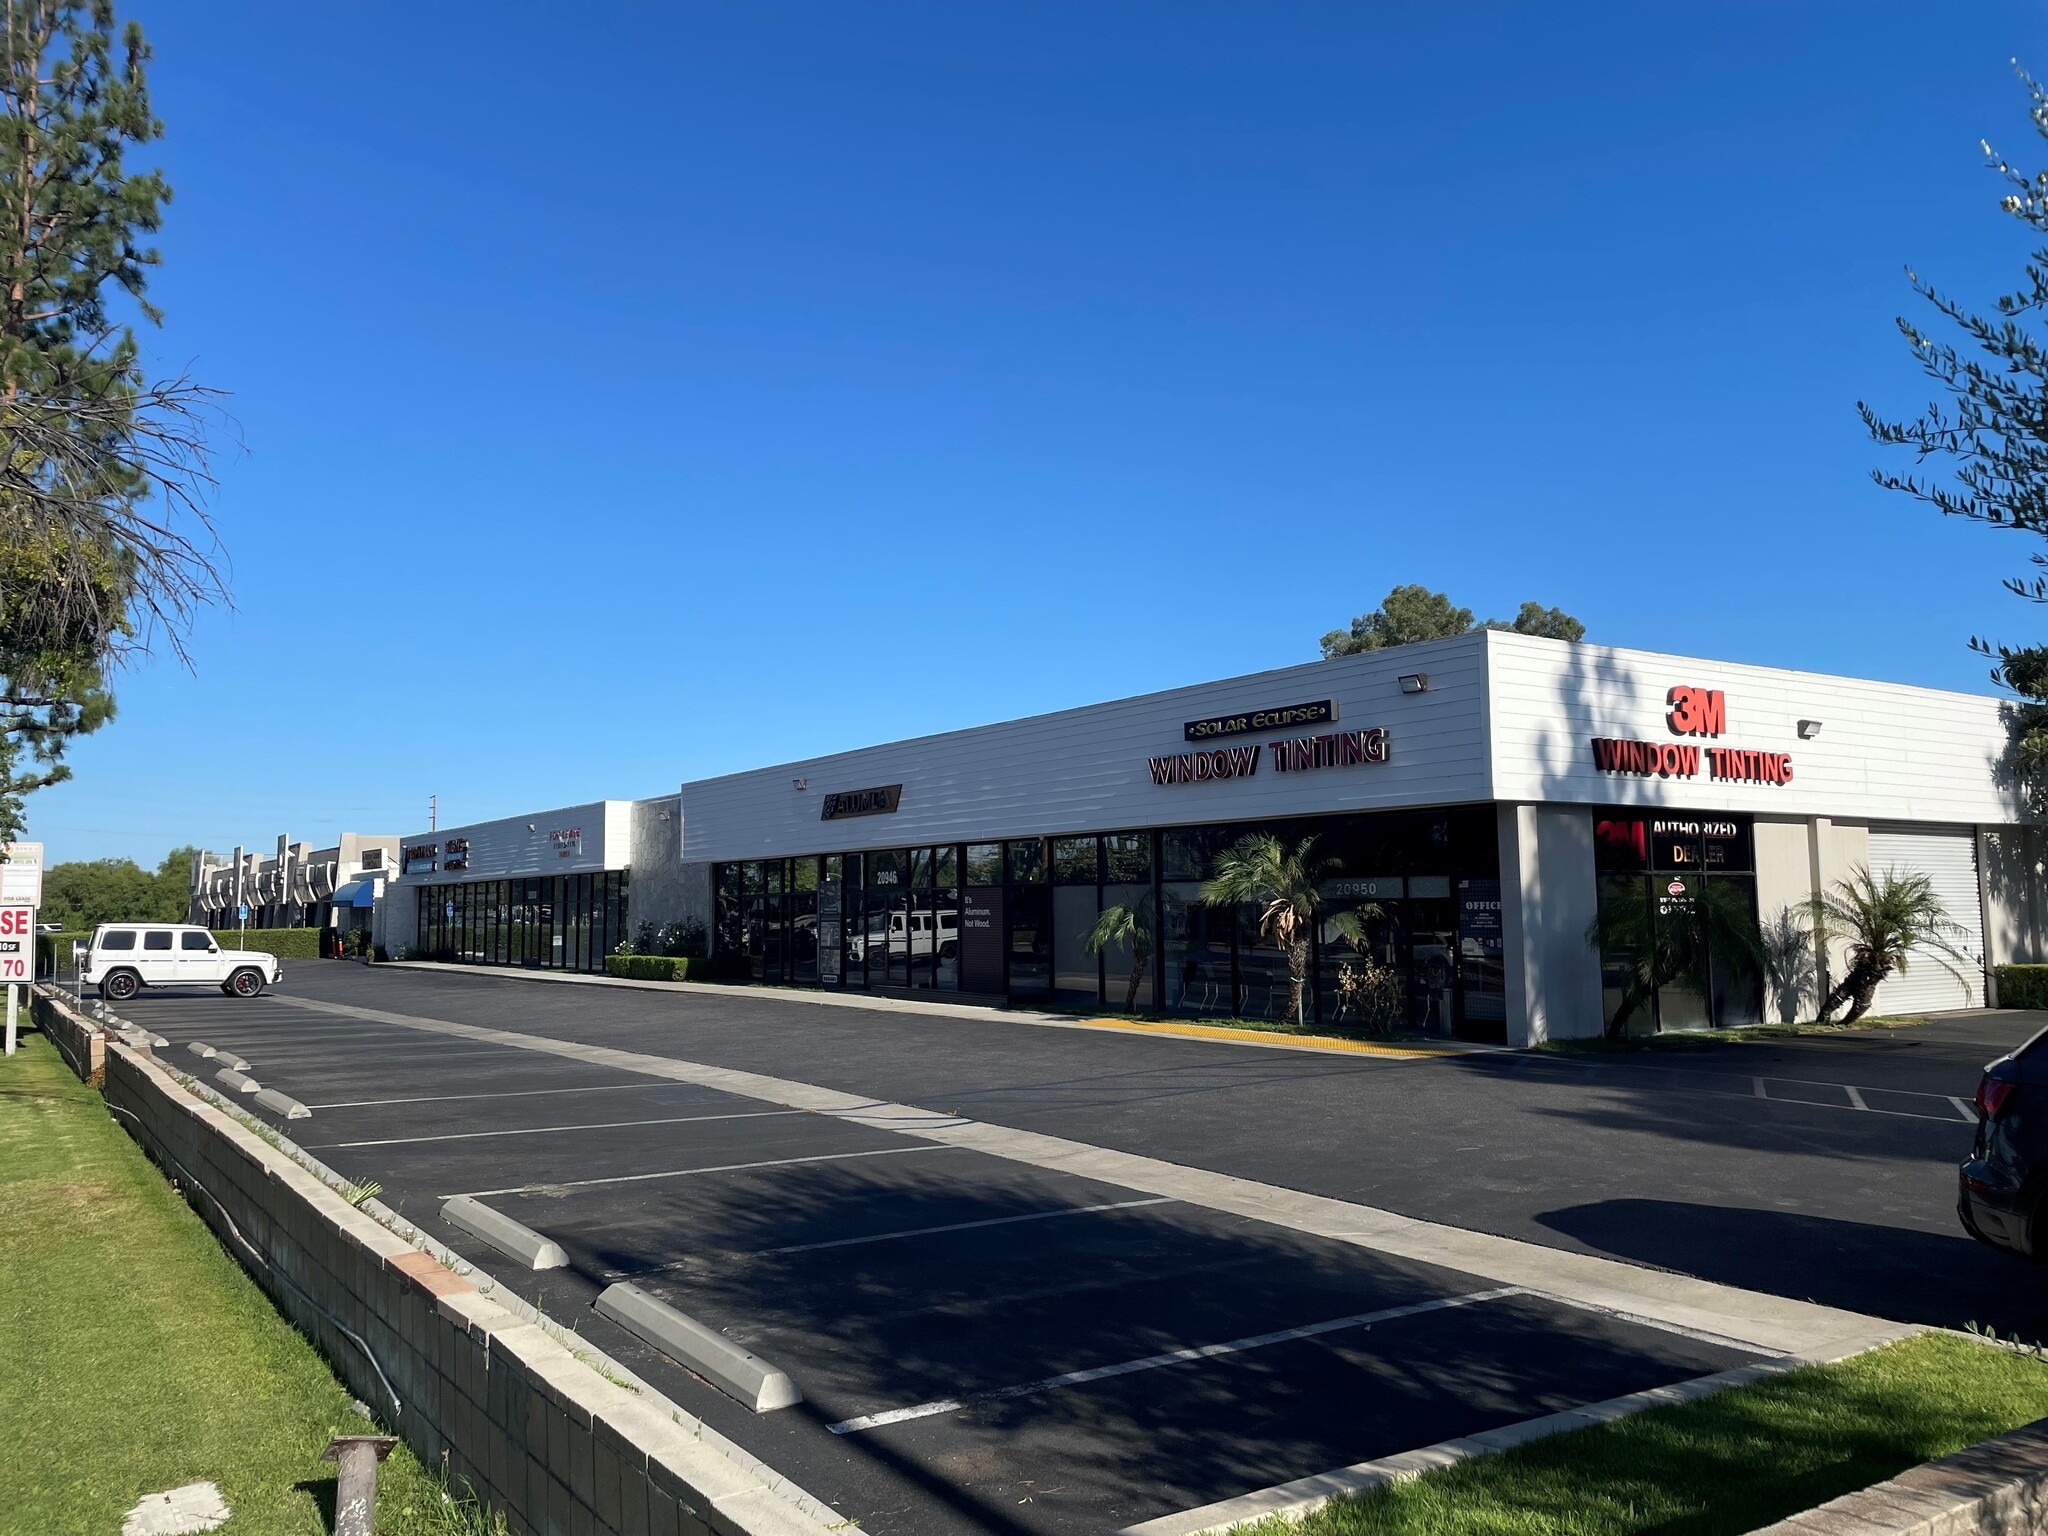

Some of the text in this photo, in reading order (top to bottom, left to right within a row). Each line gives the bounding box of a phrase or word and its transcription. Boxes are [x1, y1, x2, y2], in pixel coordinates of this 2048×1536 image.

[1195, 706, 1319, 736] SOLAR ECLIPSE
[1667, 685, 1727, 737] 3M
[1148, 727, 1390, 784] WINDOW TINTING
[1592, 738, 1794, 786] WINDOW TINTING
[1653, 820, 1737, 838] AUTHORIZED
[1673, 845, 1725, 863] DEALER
[1335, 883, 1377, 895] 20950
